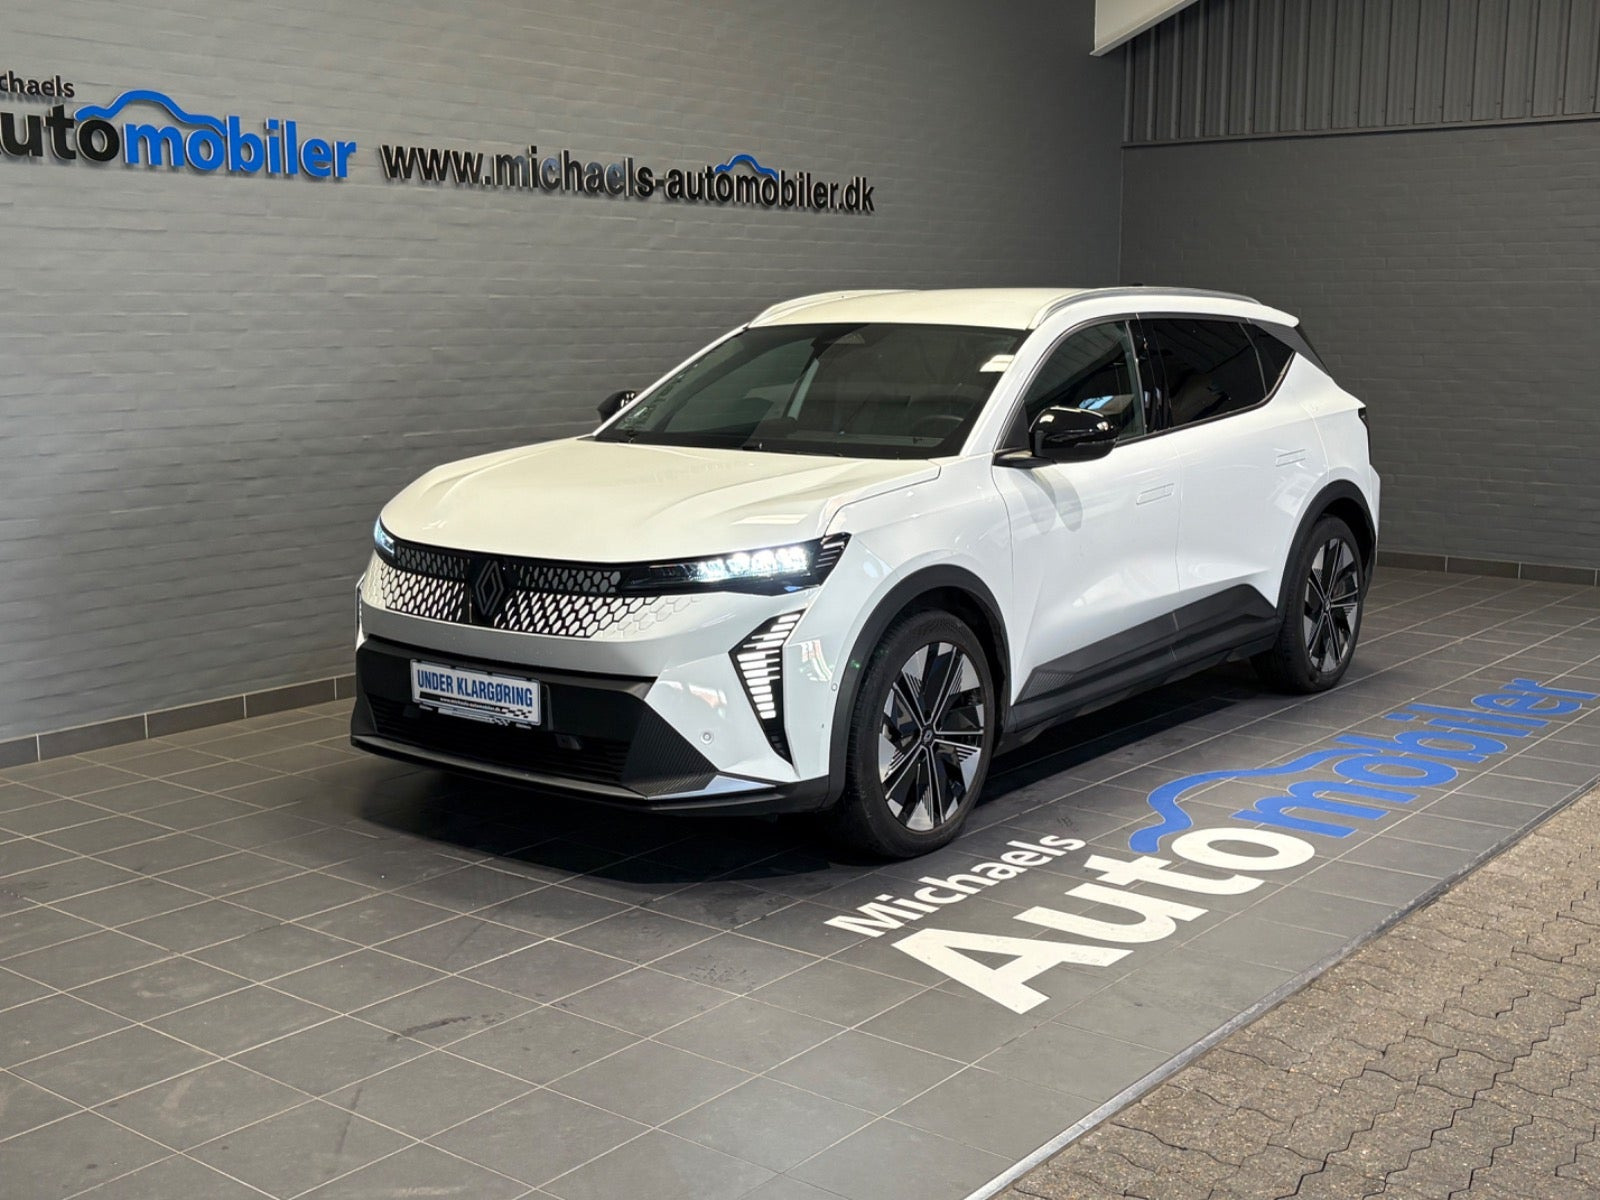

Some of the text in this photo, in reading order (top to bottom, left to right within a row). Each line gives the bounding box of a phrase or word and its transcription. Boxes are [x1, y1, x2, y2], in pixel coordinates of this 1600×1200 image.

[0, 104, 357, 178] utomobiler
[379, 144, 876, 212] www.michaels-automobiler.dk
[417, 669, 533, 708] UNDER KLARGØRING
[892, 678, 1600, 1015] Automobiler
[823, 831, 1086, 938] Michaels
